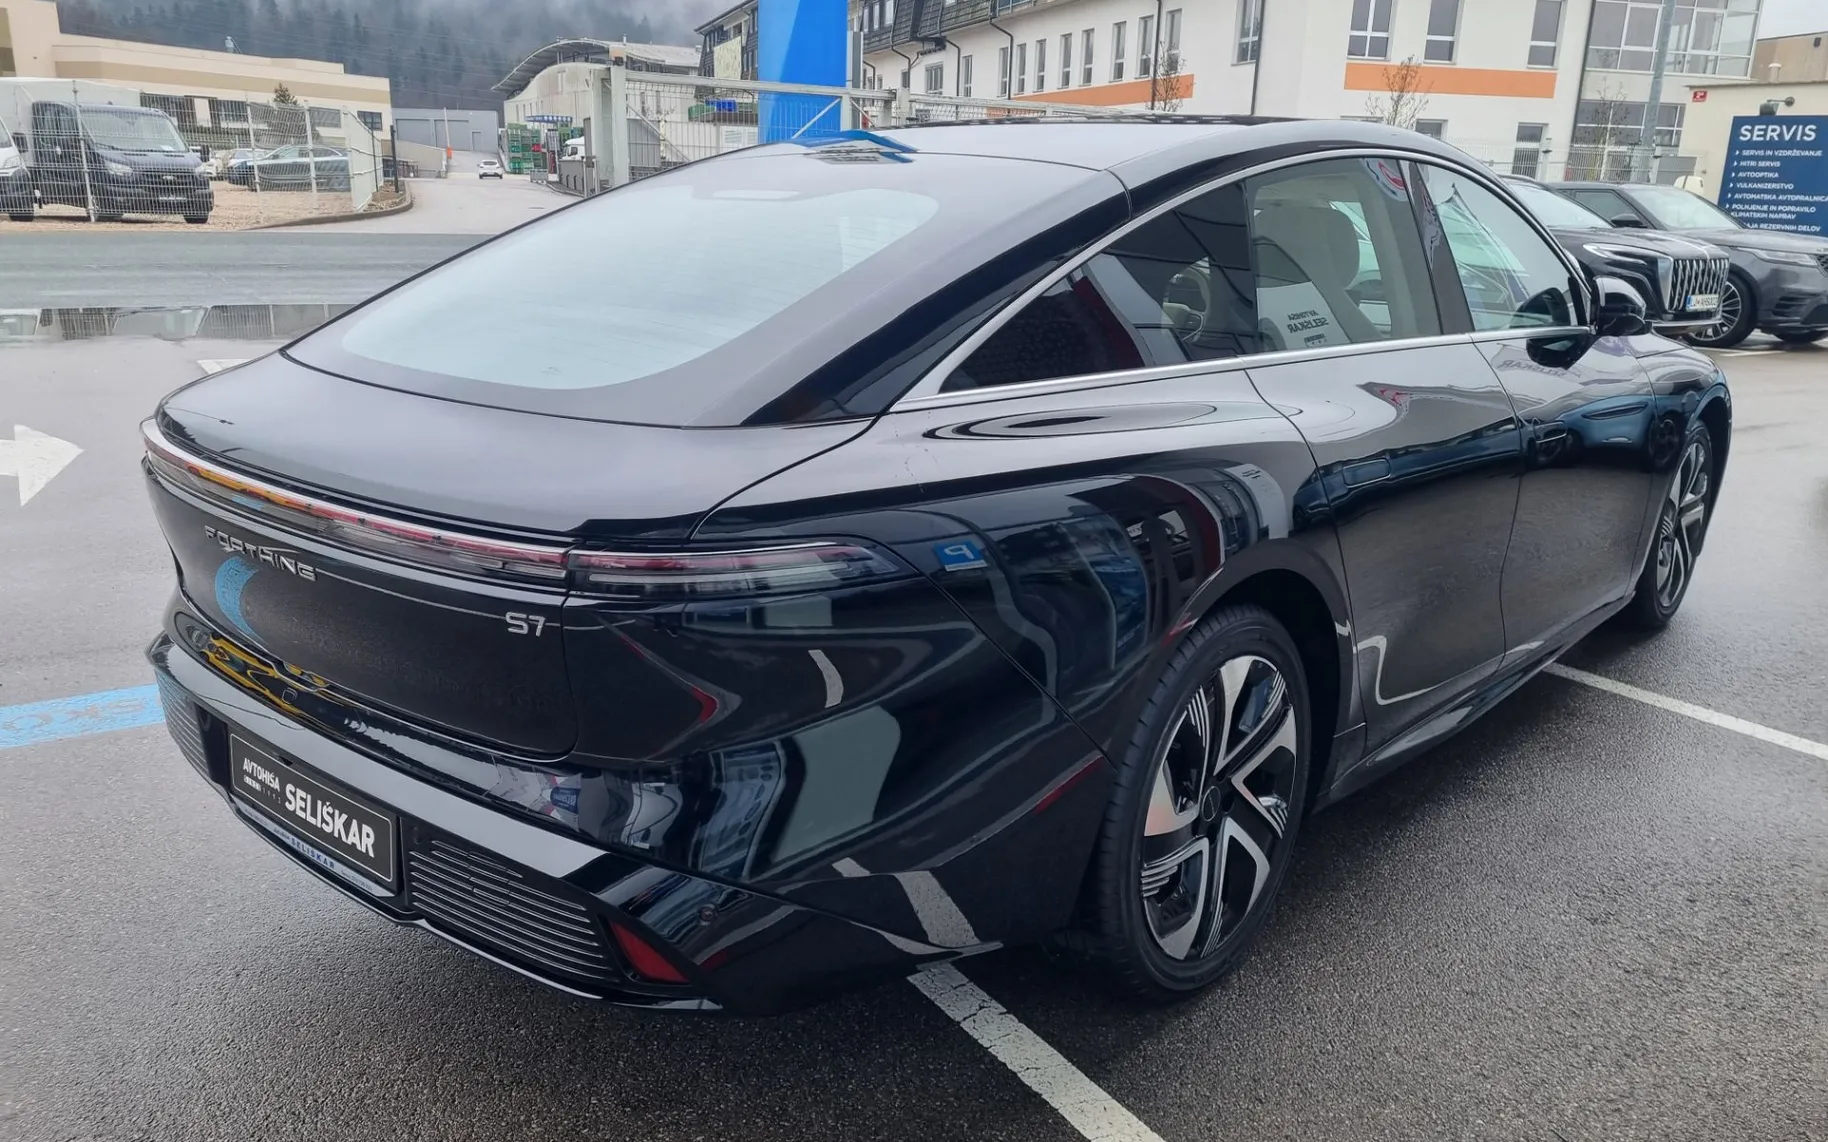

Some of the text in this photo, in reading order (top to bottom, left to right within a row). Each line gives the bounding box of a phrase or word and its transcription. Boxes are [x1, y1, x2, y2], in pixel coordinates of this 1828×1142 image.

[1739, 125, 1817, 141] SERVIS
[1732, 203, 1769, 211] POLNJENJE
[1778, 205, 1816, 213] POPRAVILO
[1768, 212, 1796, 220] NAPRAV
[1759, 223, 1797, 231] REZERVNIH
[204, 525, 316, 581] FORTHING
[505, 611, 546, 637] S7
[243, 757, 280, 793] AVTOHIŠA
[285, 783, 375, 858] SELIŠKAR
